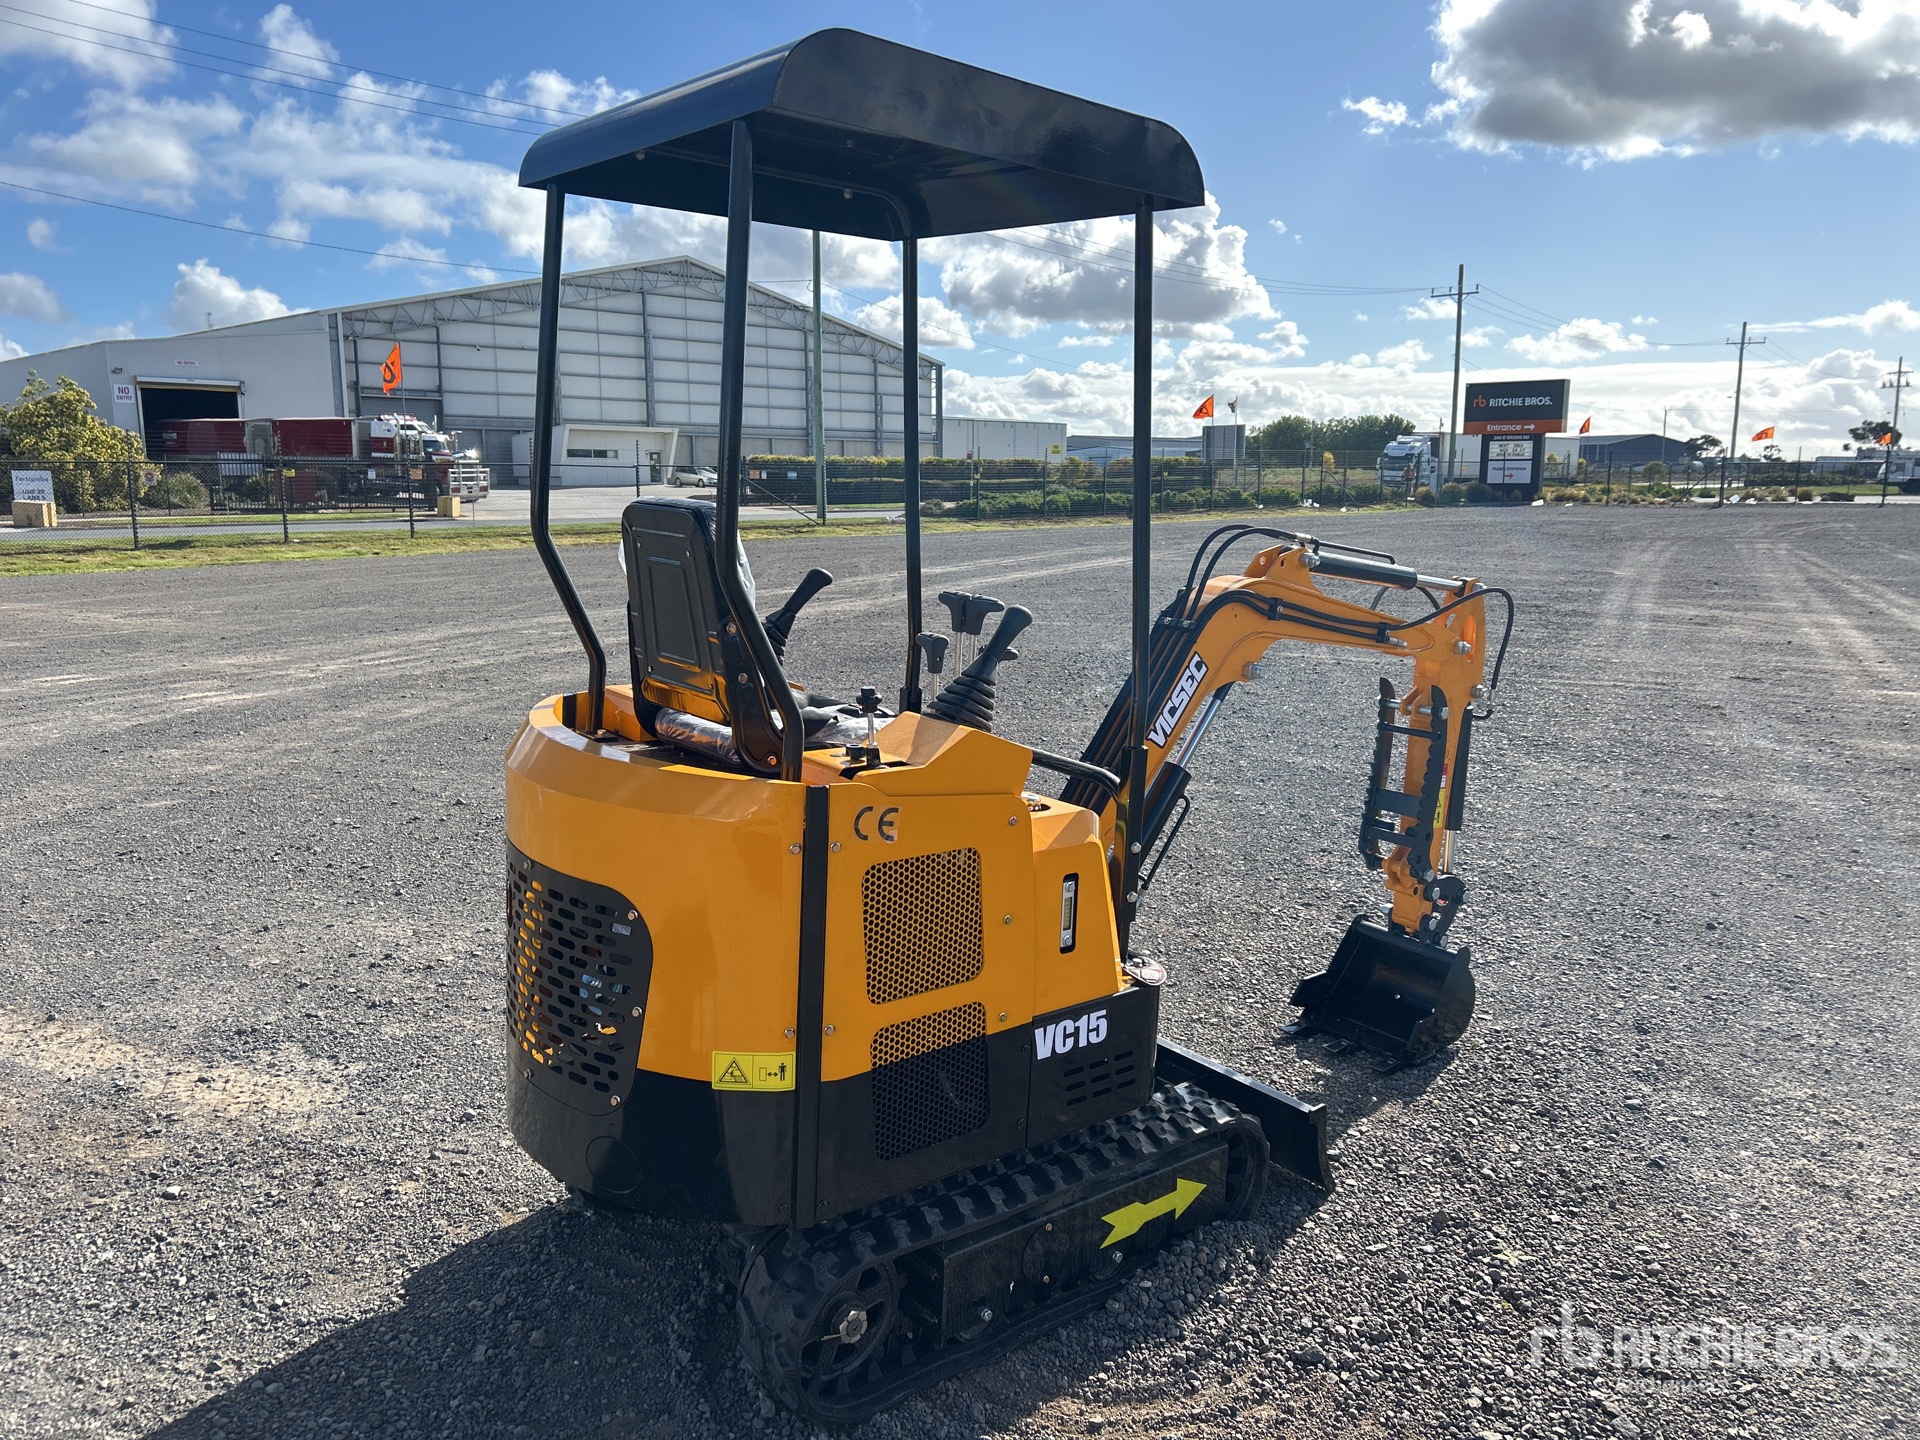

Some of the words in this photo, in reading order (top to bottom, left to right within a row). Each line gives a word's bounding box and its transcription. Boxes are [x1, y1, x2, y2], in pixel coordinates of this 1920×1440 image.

[118, 386, 130, 395] NO
[1489, 397, 1524, 407] RITCHIE
[1525, 396, 1553, 405] BROS.
[1487, 423, 1522, 432] Entrance
[1146, 652, 1209, 748] VICSEC
[854, 805, 900, 842] CE
[1034, 1009, 1108, 1060] VC15
